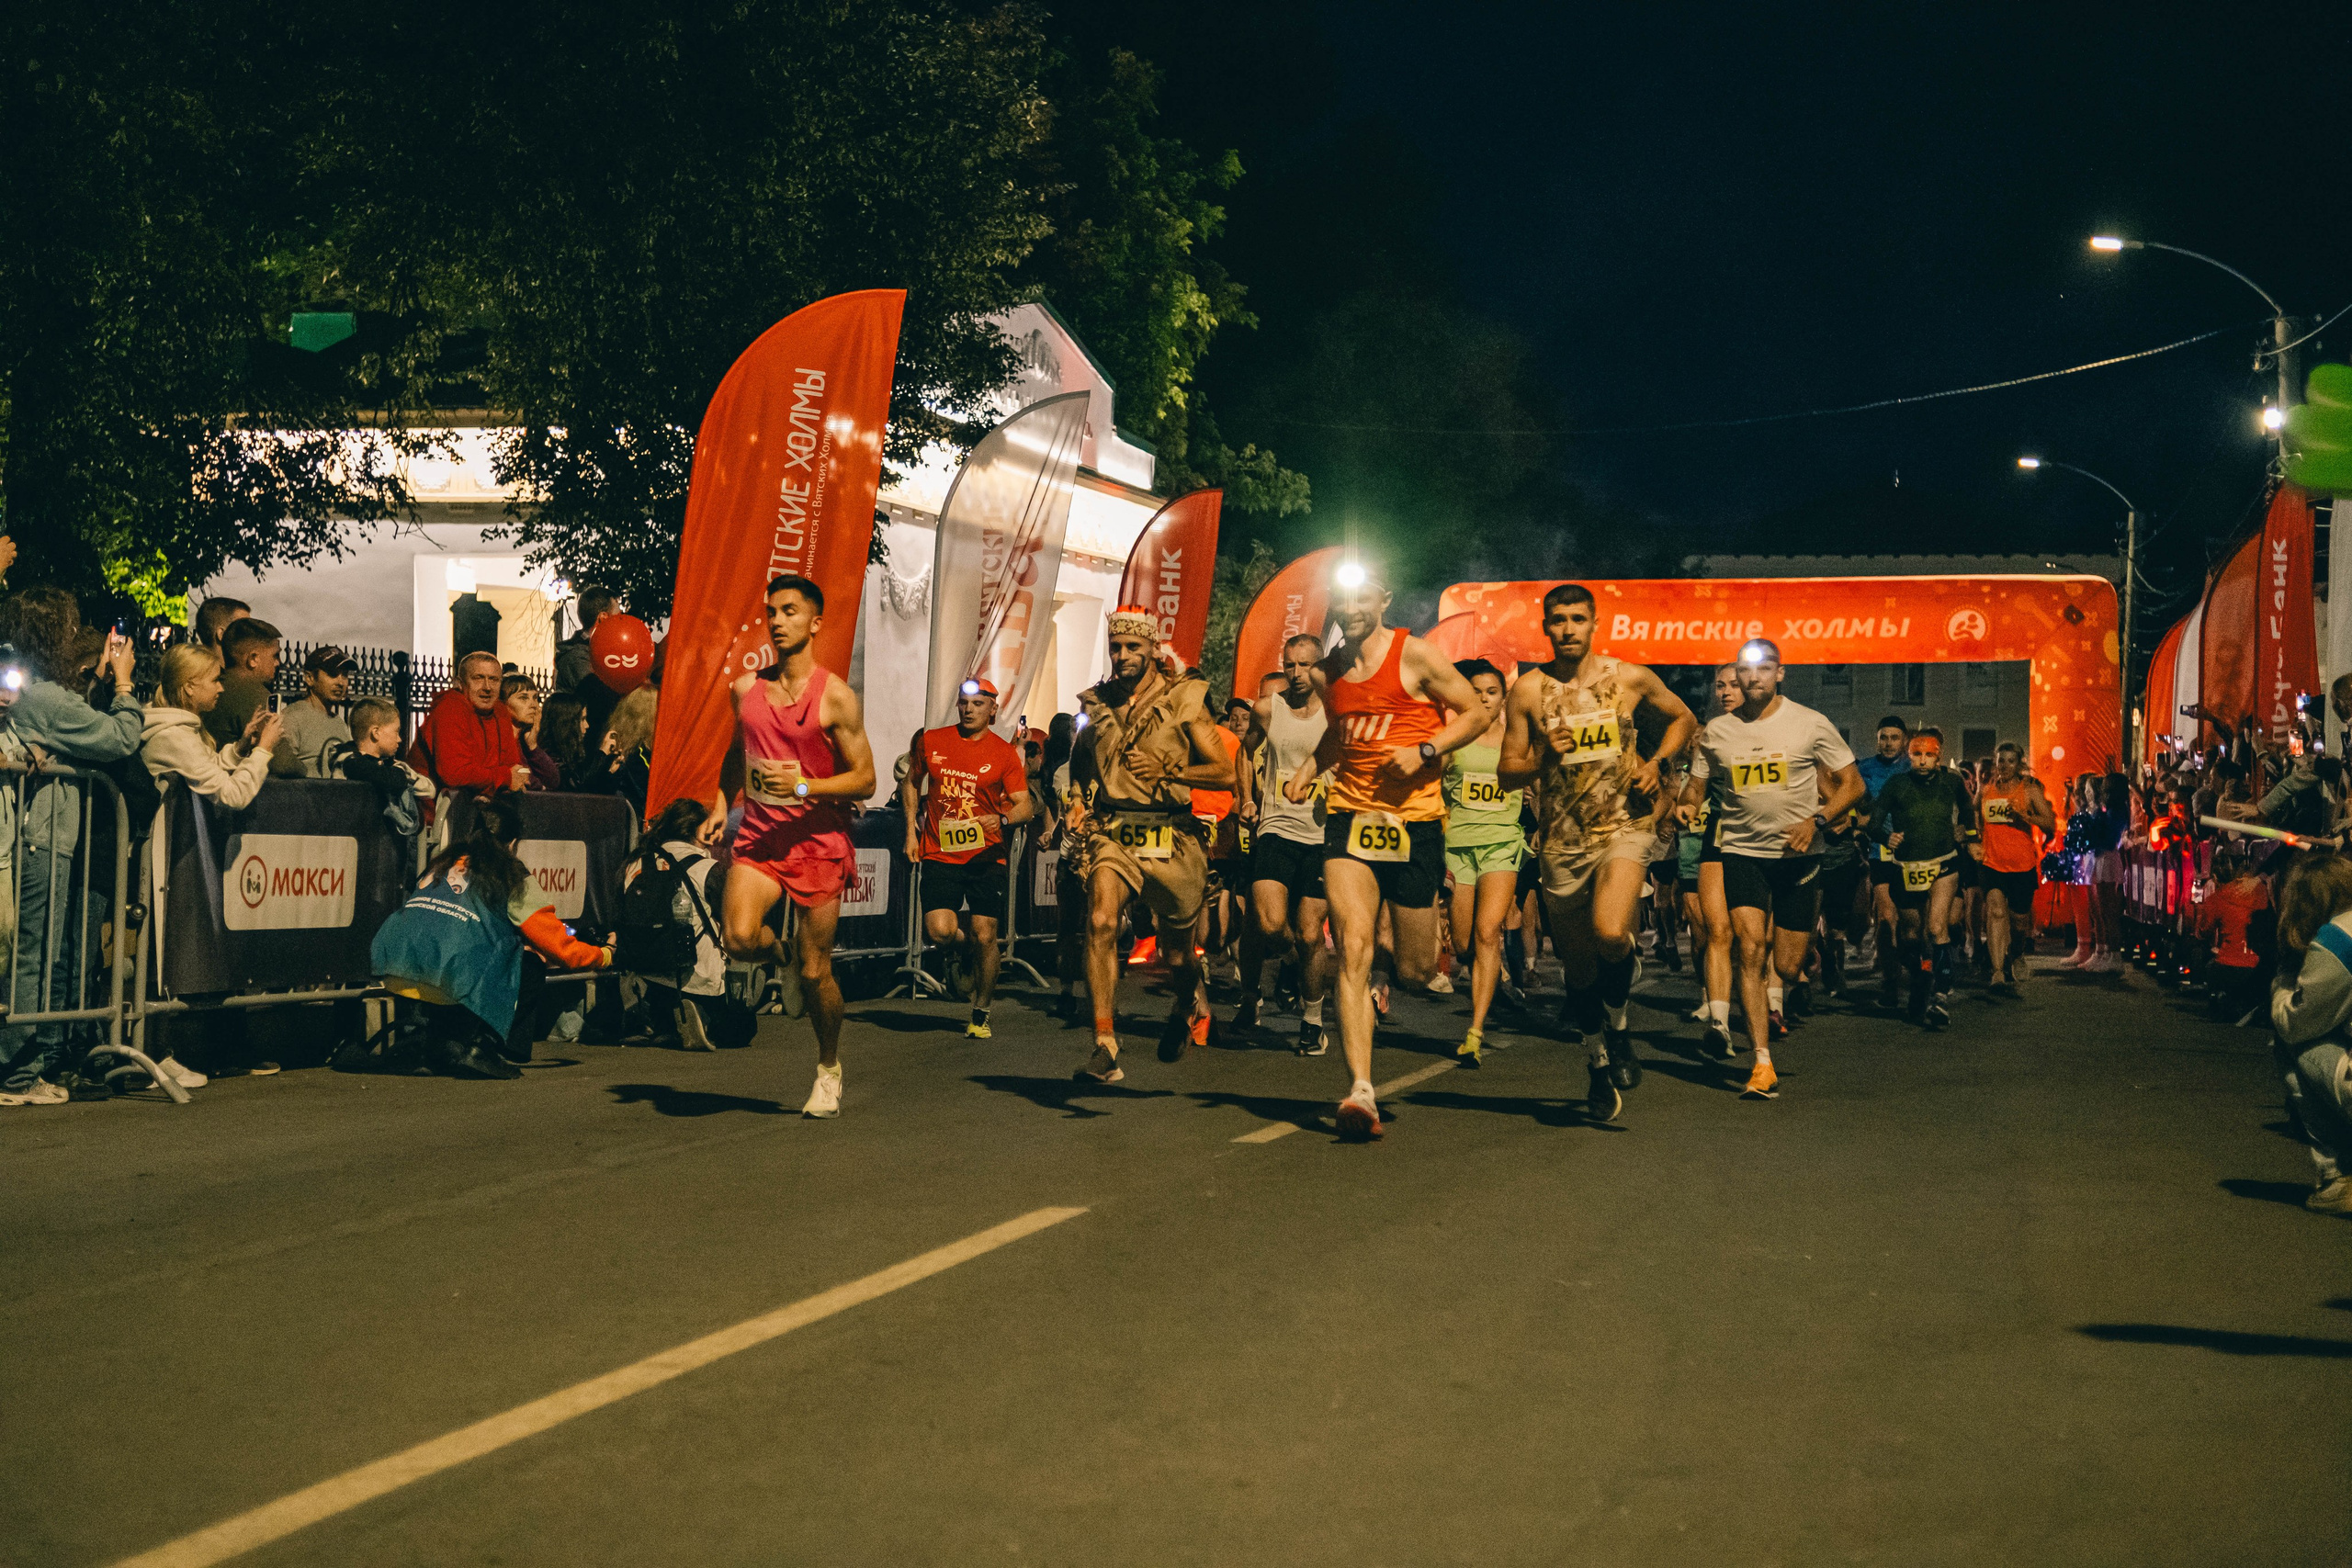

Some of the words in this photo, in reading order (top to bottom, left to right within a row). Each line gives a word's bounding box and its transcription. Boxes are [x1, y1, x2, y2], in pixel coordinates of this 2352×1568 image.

[784, 367, 826, 473] ХОЛМЫ
[811, 464, 829, 508] Вятских
[763, 475, 811, 604] ЯТСКИЕ
[804, 516, 820, 579] ачинается
[1610, 614, 1764, 642] Вятские
[1781, 616, 1910, 639] холмы
[940, 768, 978, 781] МАРАФОН
[1739, 762, 1781, 785] 715
[1468, 783, 1506, 804] 504
[944, 827, 978, 845] 109
[1119, 824, 1161, 848] 651
[1359, 825, 1402, 851] 639
[1908, 868, 1937, 886] 655
[436, 907, 468, 922] ОБЛАСТИ
